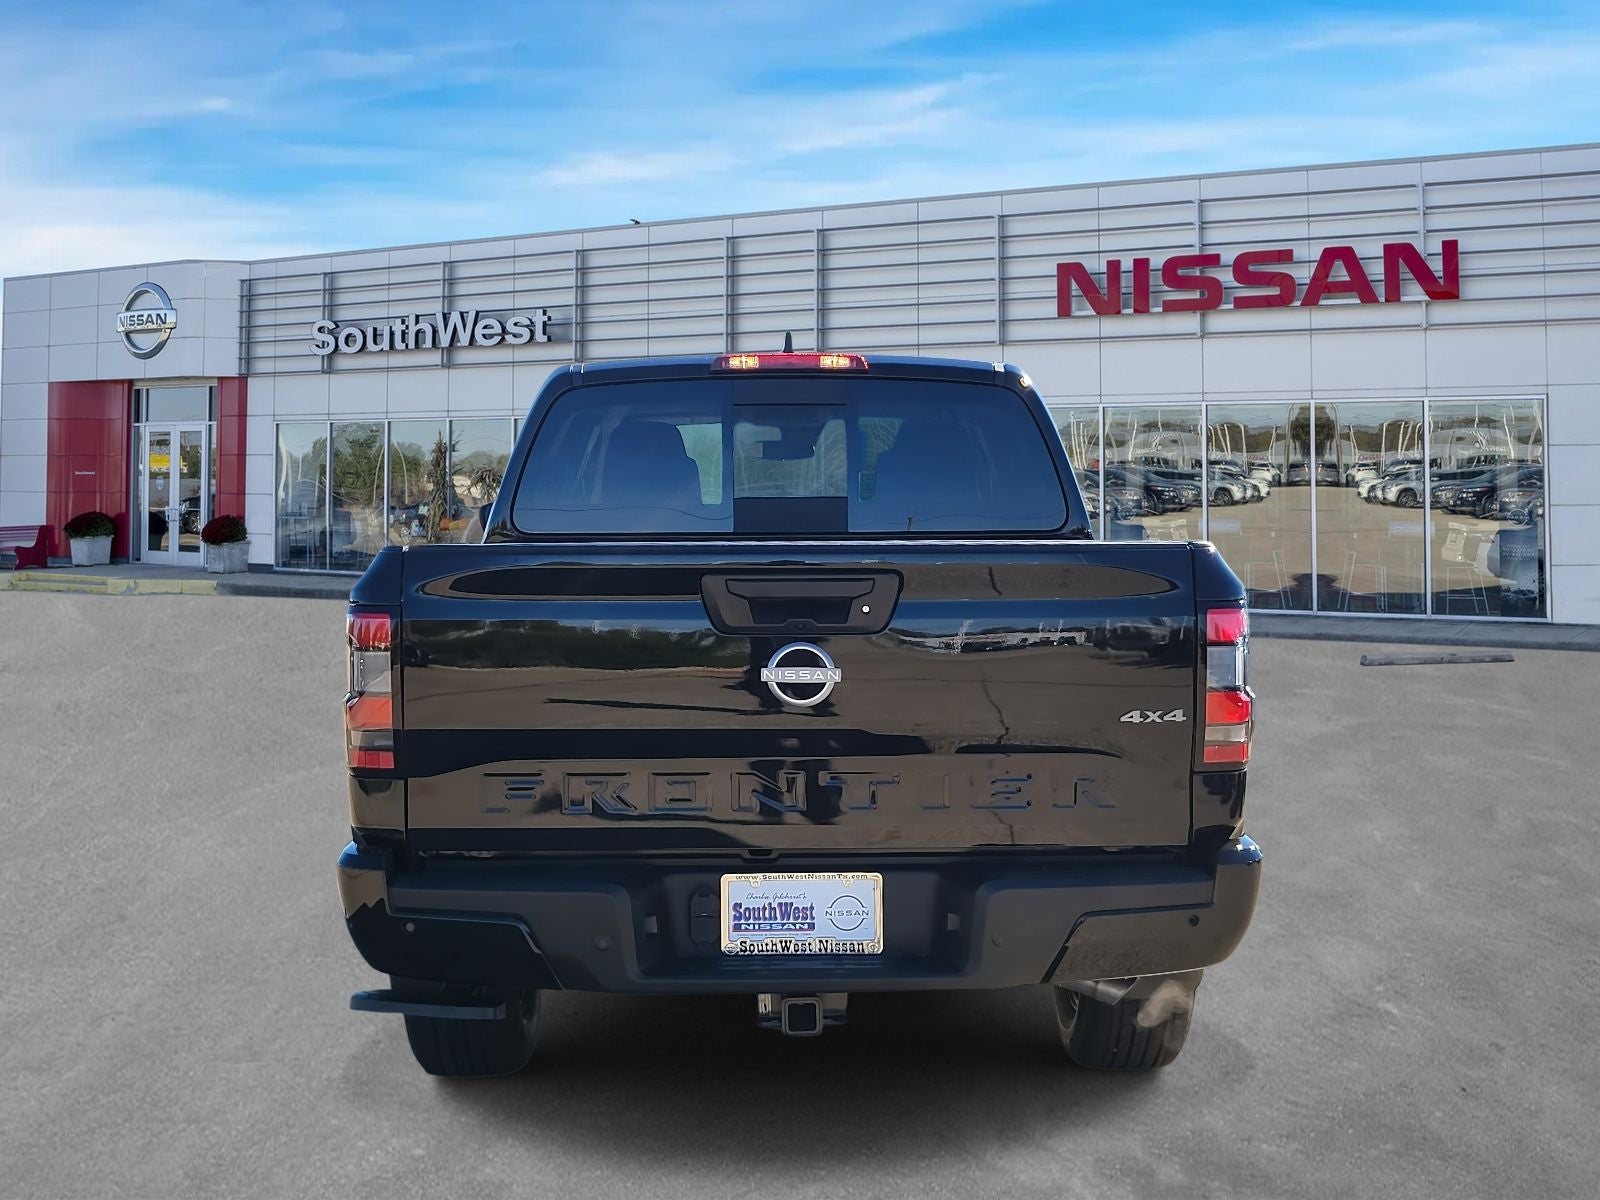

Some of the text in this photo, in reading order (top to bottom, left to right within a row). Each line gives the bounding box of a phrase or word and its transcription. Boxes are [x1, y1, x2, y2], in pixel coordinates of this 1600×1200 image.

[1056, 239, 1461, 318] NISSAN
[119, 312, 168, 328] NISSAN
[309, 307, 552, 356] SouthWest
[762, 670, 840, 681] NISSAN
[481, 771, 1118, 813] FRONTIER
[735, 873, 868, 881] www.SouthWestNissanTx.com
[732, 901, 816, 922] SouthWest
[824, 909, 870, 918] NISSAN
[741, 923, 809, 931] NISSAN
[739, 940, 865, 953] SouthWest Nissan
